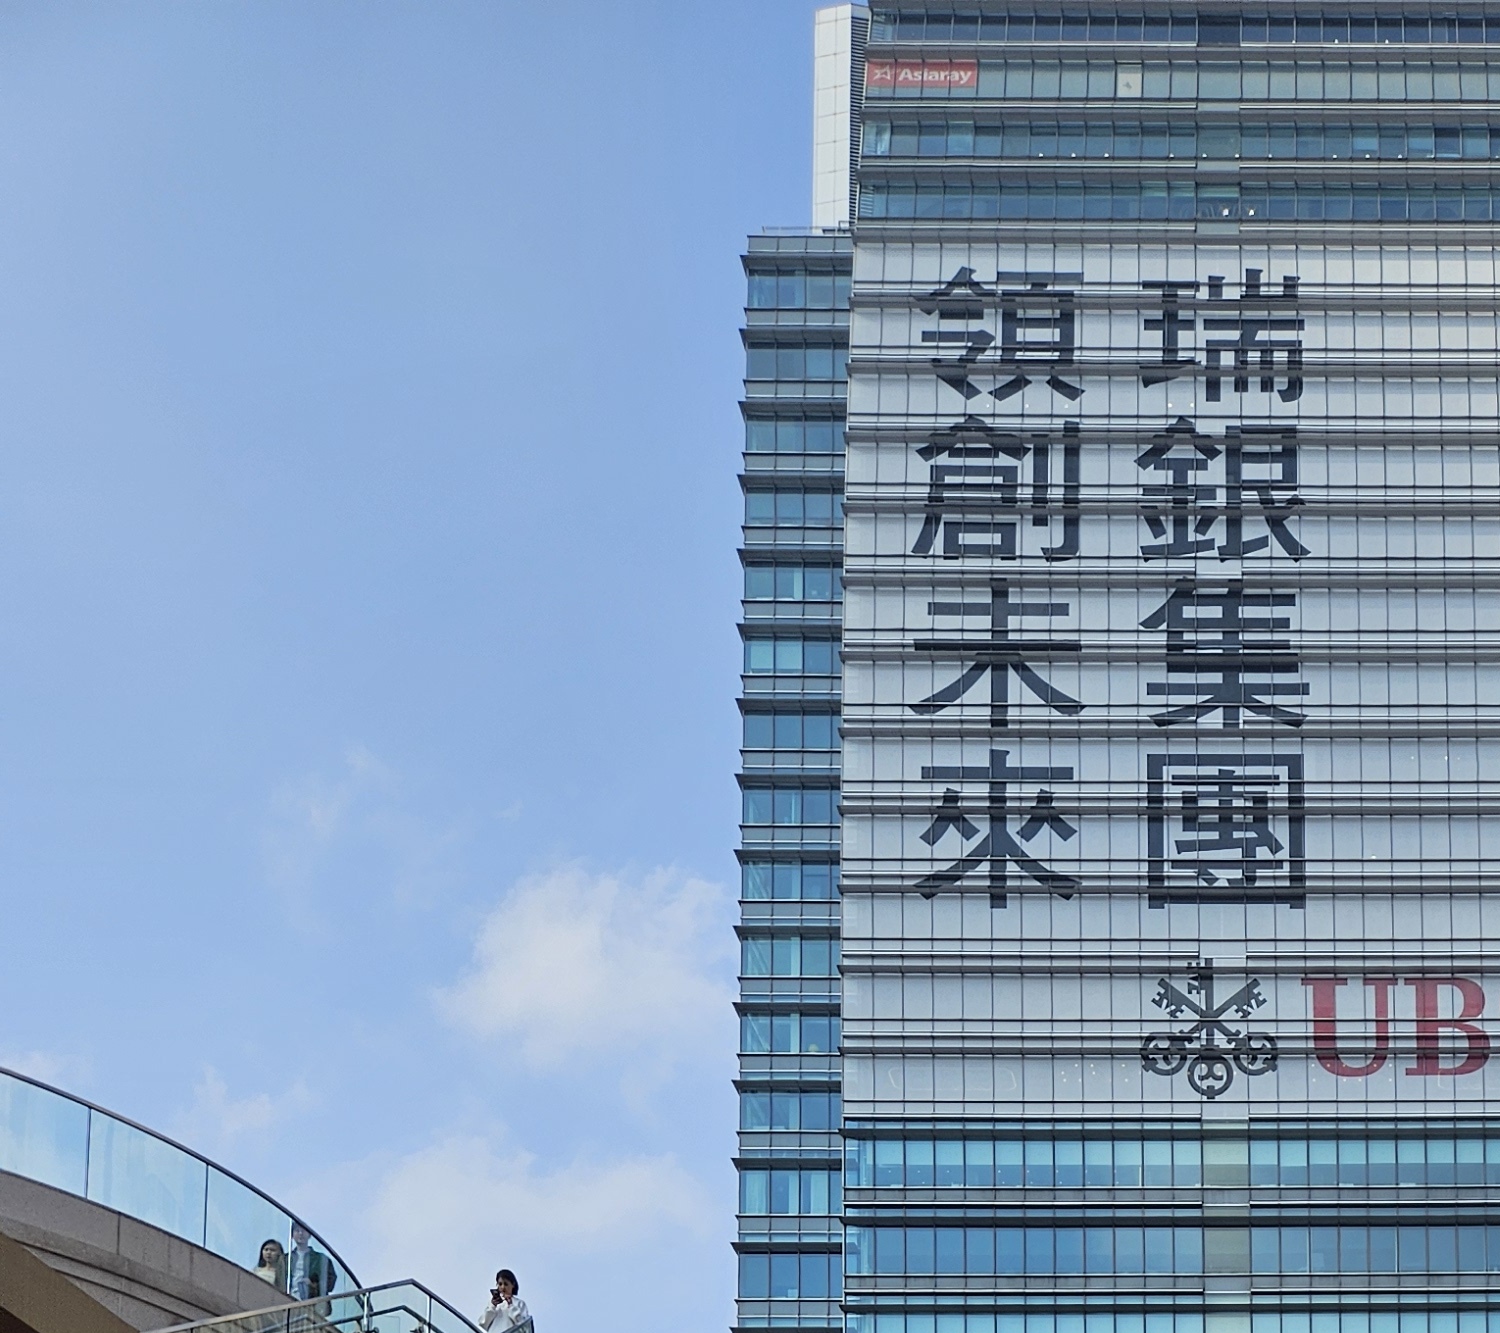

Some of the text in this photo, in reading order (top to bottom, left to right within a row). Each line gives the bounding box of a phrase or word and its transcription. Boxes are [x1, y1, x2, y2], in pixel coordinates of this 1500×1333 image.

[898, 67, 972, 84] Asiaray
[907, 265, 1089, 909] 領創未來
[1133, 267, 1312, 909] 瑞銀集團
